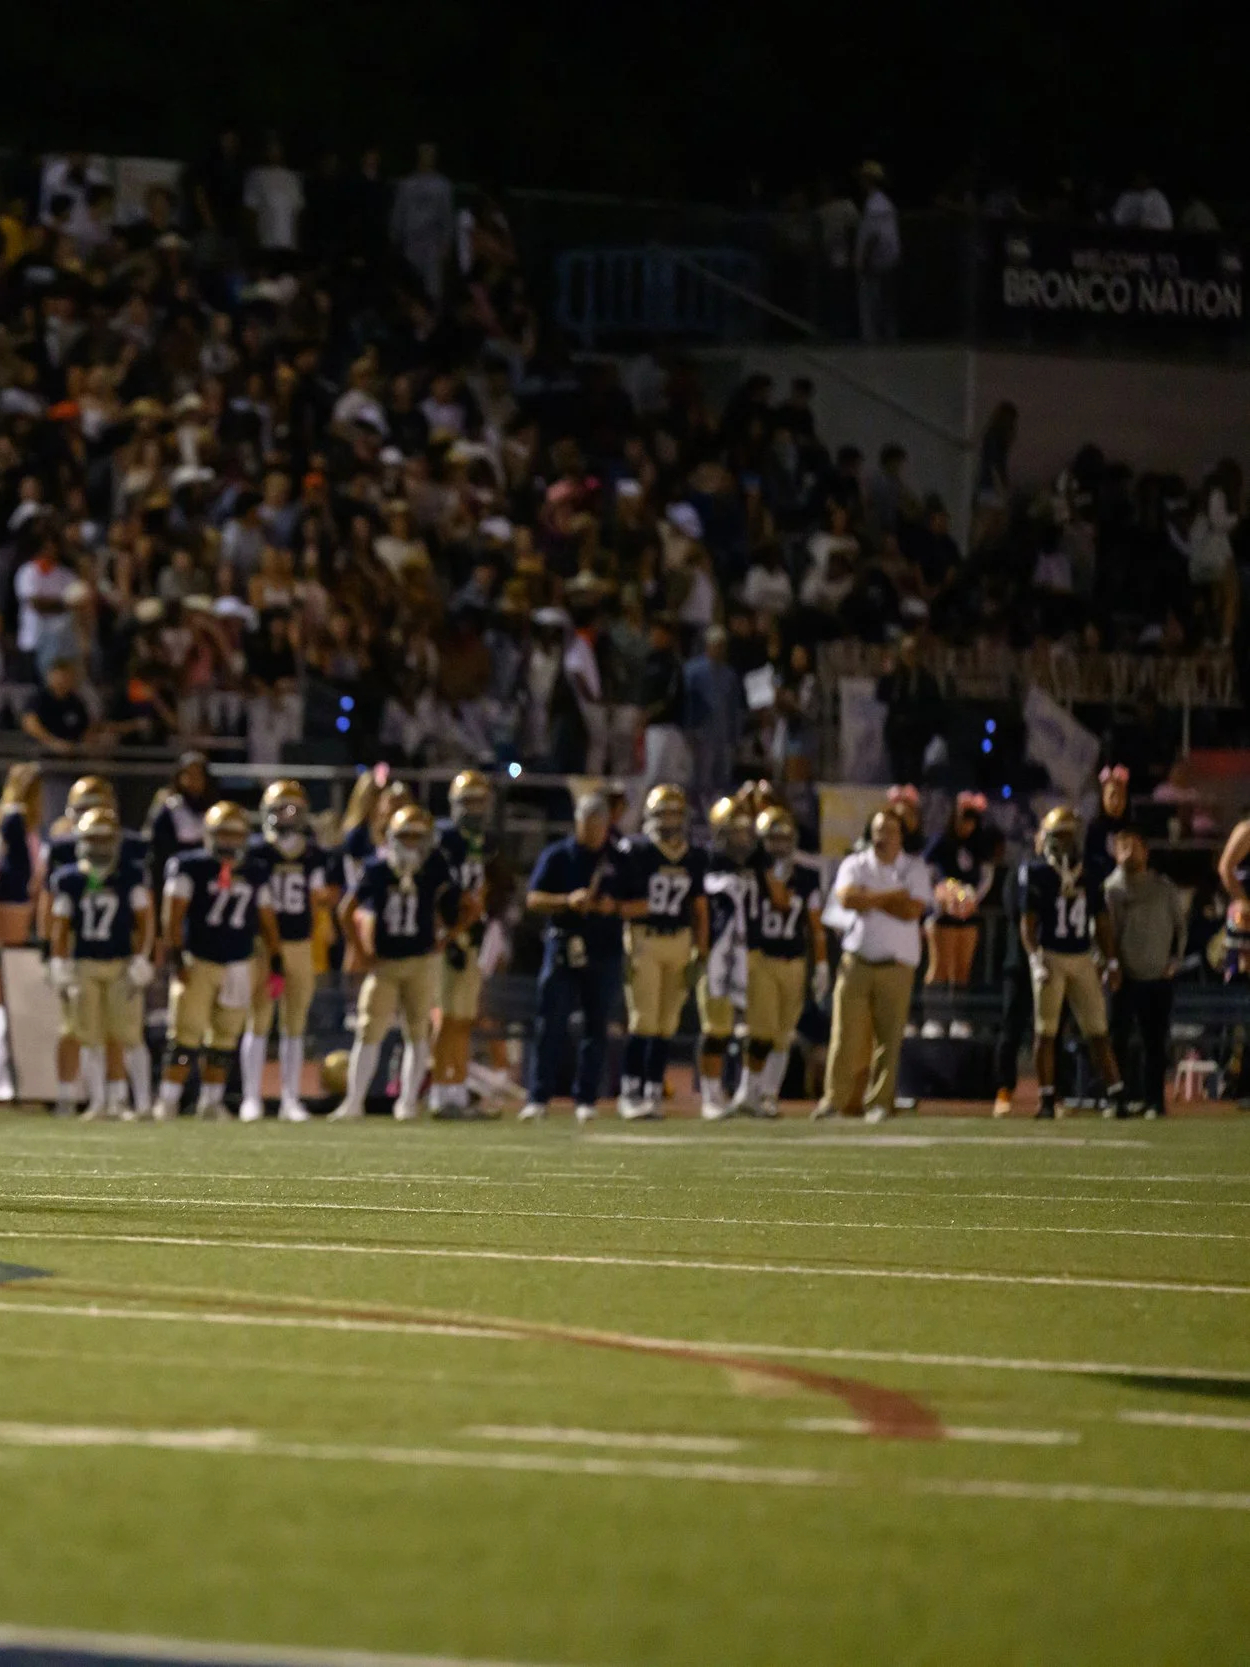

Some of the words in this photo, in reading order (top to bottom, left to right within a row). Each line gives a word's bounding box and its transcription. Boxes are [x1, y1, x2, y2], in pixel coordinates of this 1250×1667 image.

[1002, 267, 1132, 314] BRONCO
[1137, 274, 1242, 320] NATION
[79, 891, 120, 942] 17
[205, 879, 254, 930] 77
